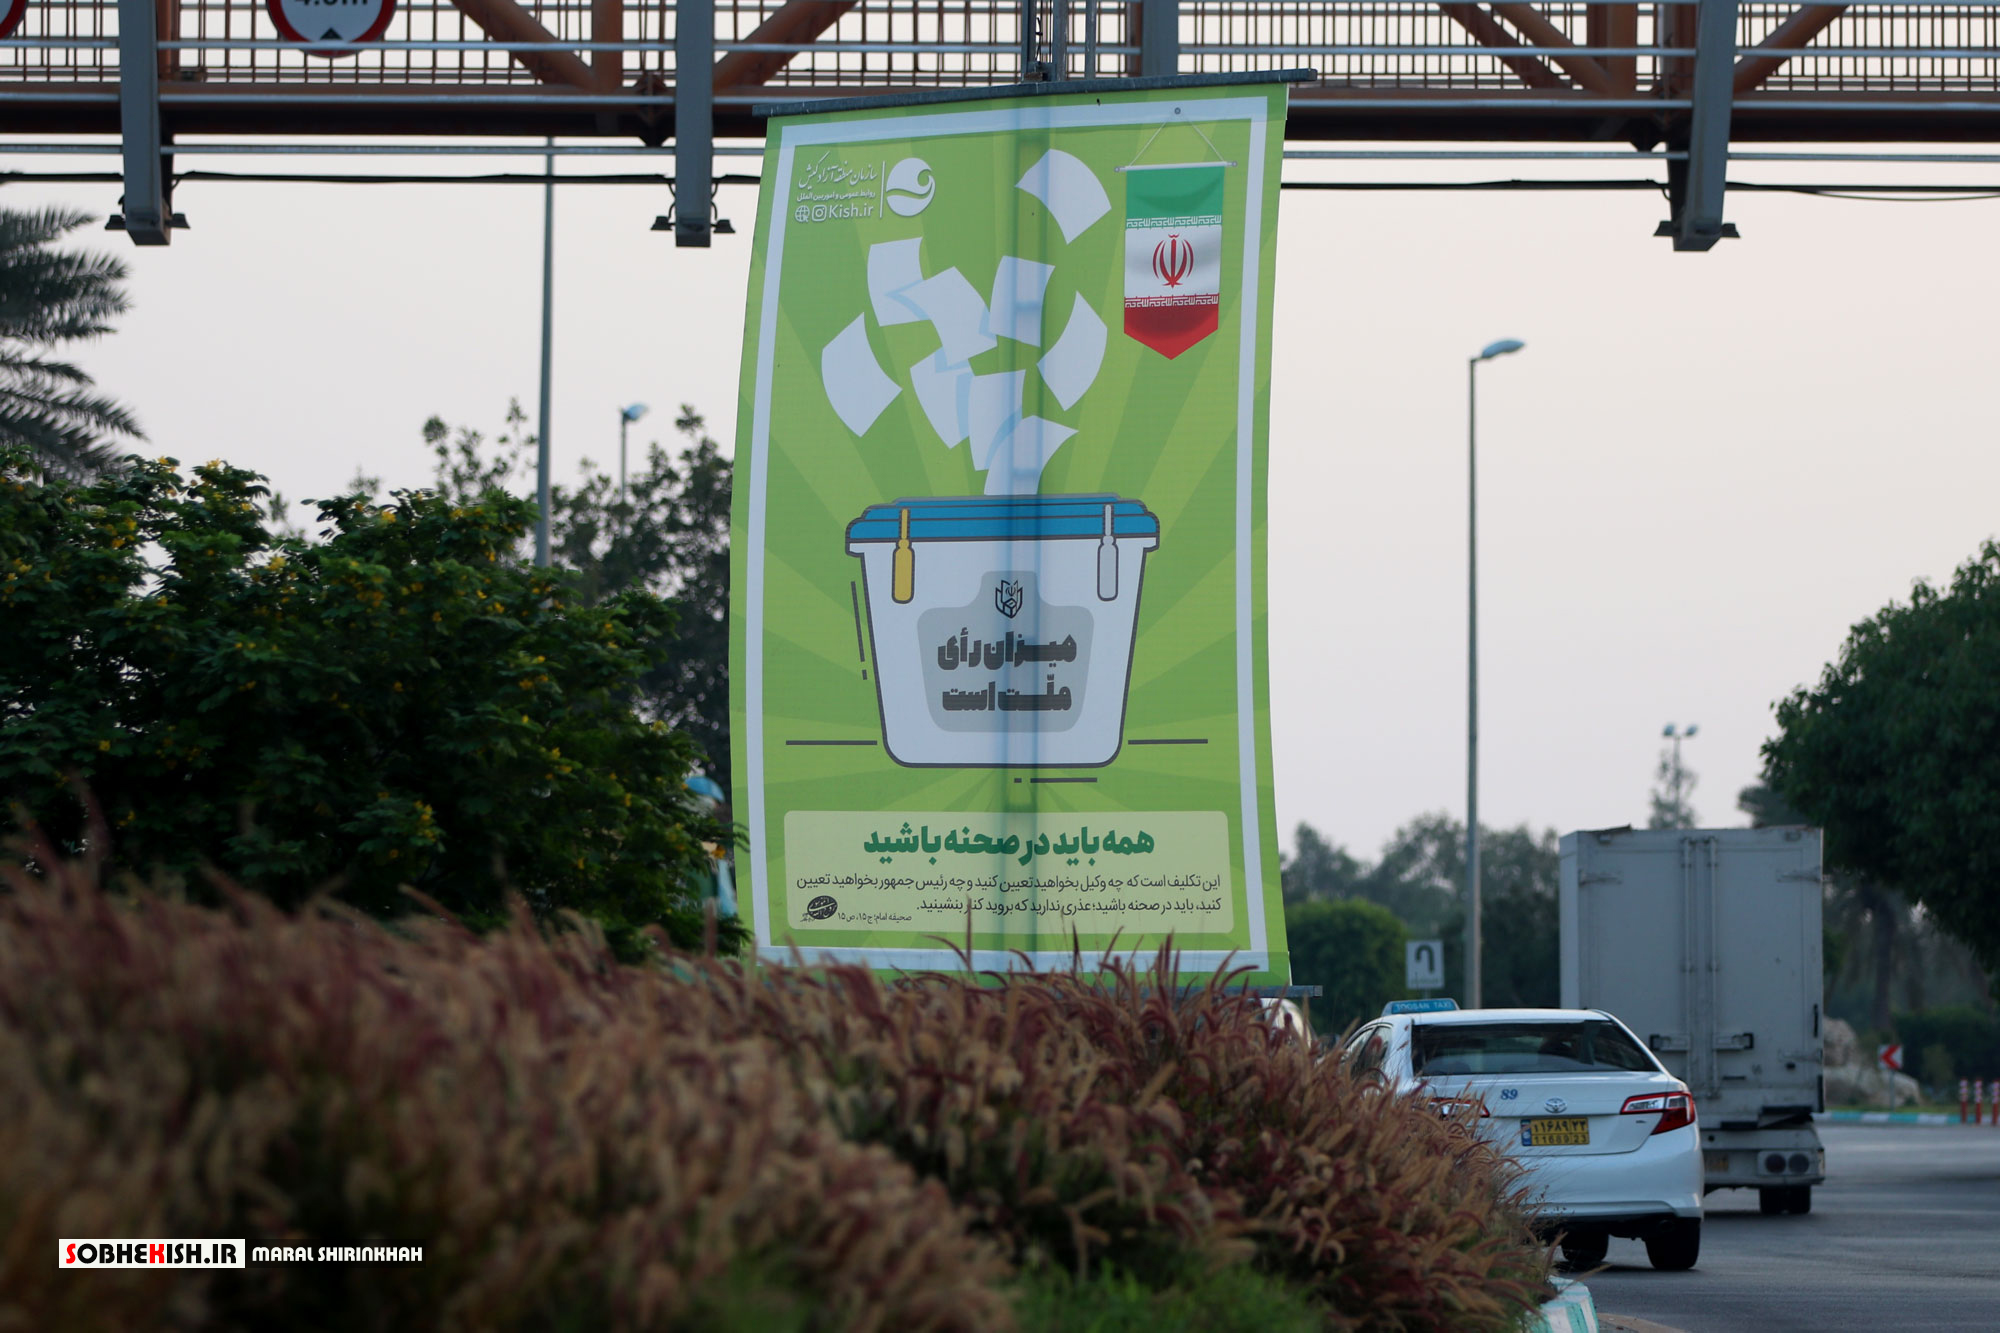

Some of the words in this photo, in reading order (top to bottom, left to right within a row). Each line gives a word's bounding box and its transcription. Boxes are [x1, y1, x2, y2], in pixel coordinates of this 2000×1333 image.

[798, 150, 831, 190] کیش
[817, 164, 839, 183] آزاد
[850, 164, 878, 186] سازمان
[829, 202, 874, 219] Kish.ir
[937, 626, 982, 670] رأی
[983, 631, 1078, 670] میزان
[942, 681, 996, 711] است
[864, 821, 941, 866] باشید
[944, 826, 1020, 855] صحنه
[1018, 832, 1050, 866] در
[1053, 826, 1100, 866] باید
[1102, 829, 1155, 855] همه
[796, 873, 831, 890] تعیین
[832, 873, 878, 889] بخواهید
[879, 877, 914, 890] جمهور
[915, 874, 948, 891] رئیس
[949, 877, 966, 892] چه
[966, 879, 973, 891] و
[975, 875, 998, 891] کنید
[1000, 877, 1033, 892] تعیین
[1034, 874, 1079, 892] بخواهید
[1080, 874, 1107, 892] وکیل
[1108, 877, 1124, 892] چه
[1126, 874, 1140, 888] که
[1140, 874, 1166, 888] است
[1167, 873, 1201, 890] تکلیف
[1203, 874, 1221, 891] این
[917, 897, 963, 914] بنشینید.
[964, 898, 984, 914] کنر
[985, 900, 1014, 916] بروید
[1014, 898, 1029, 911] که
[1030, 899, 1060, 915] ندارید
[1062, 899, 1091, 916] عذری
[1128, 899, 1160, 911] صحنه
[1161, 899, 1172, 915] در
[1173, 898, 1194, 914] باید
[1196, 897, 1222, 914] کنید،
[889, 912, 912, 923] صحیفه
[1500, 1088, 1518, 1100] 89
